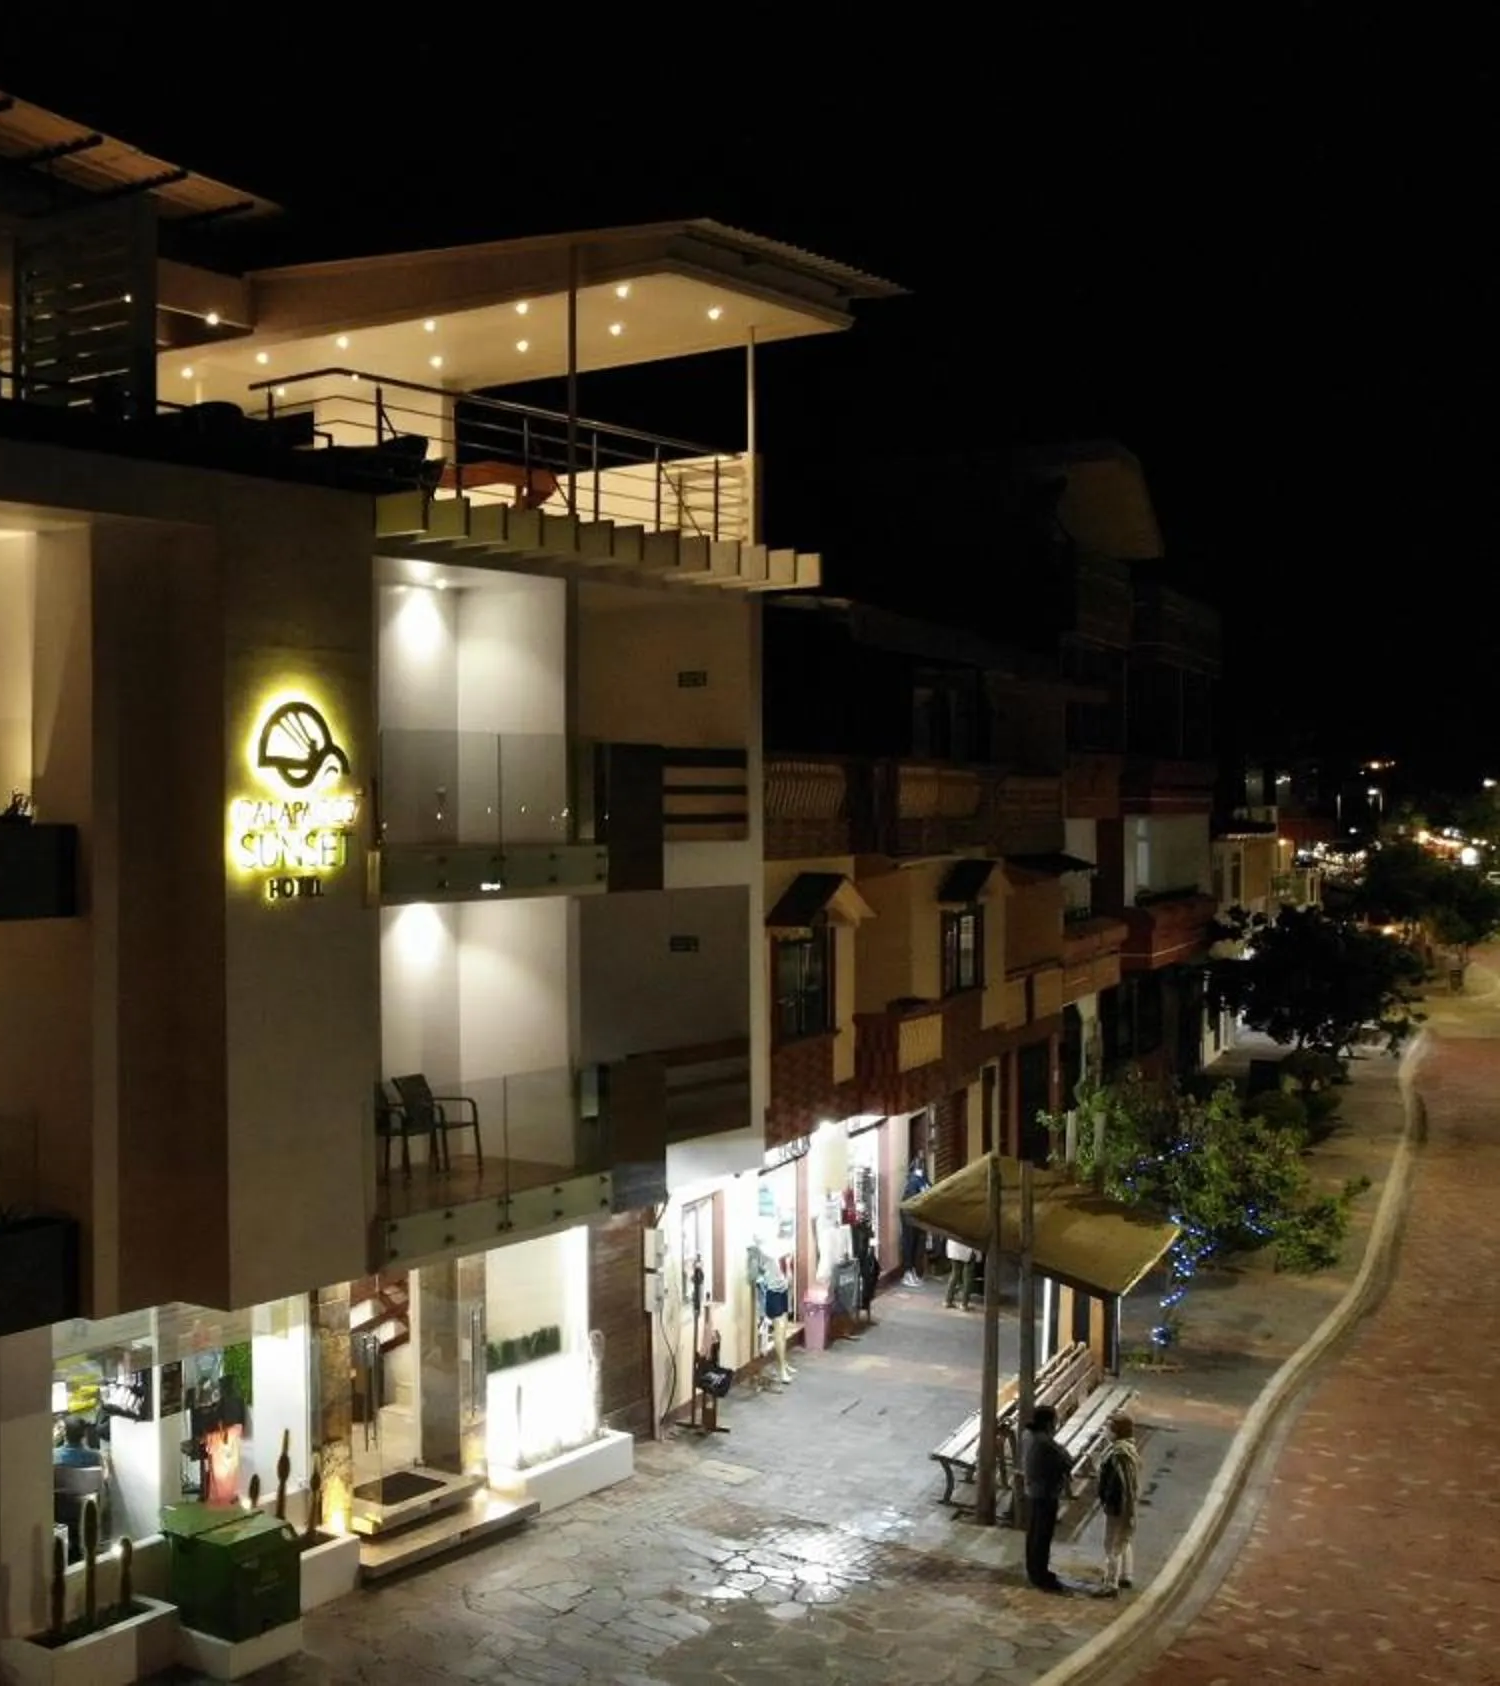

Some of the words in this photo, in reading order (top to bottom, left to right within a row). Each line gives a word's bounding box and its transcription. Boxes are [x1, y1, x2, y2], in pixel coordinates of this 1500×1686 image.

[237, 799, 358, 825] ALAPA
[240, 830, 352, 868] SUNSET
[269, 877, 324, 898] HOTEL
